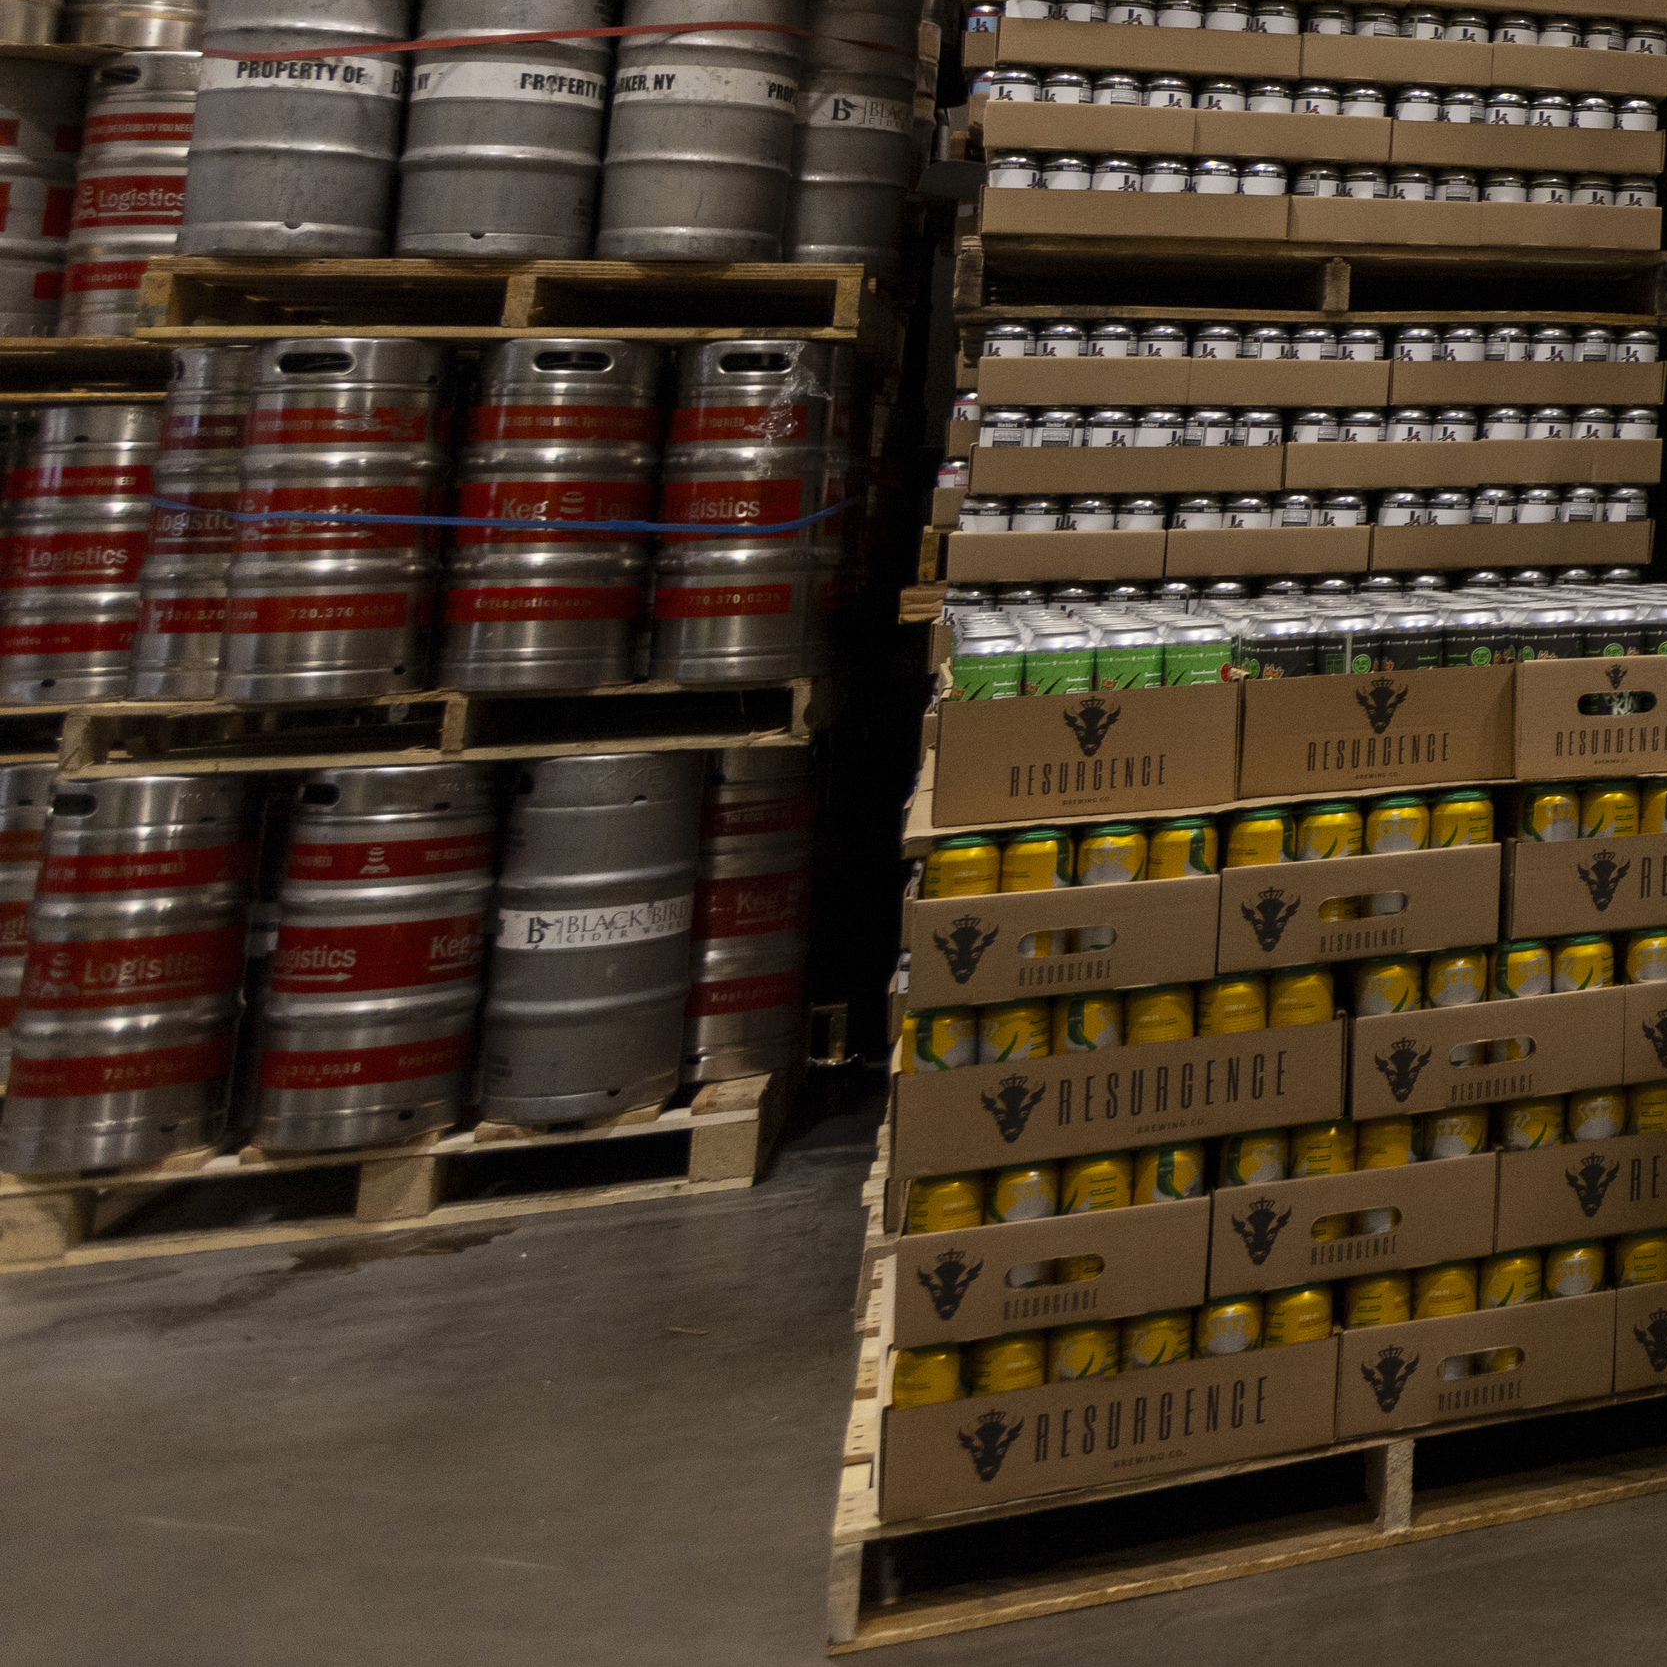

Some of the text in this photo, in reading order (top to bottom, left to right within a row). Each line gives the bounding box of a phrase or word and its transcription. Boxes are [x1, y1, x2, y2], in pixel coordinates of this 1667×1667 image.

[236, 61, 365, 84] PROPERTY OF
[654, 73, 676, 90] NY
[502, 500, 548, 521] Keg
[29, 545, 129, 572] Logistics
[1307, 732, 1449, 772] RESURGENCE
[1009, 754, 1166, 798] RESURGENCE
[566, 909, 644, 934] BLACK
[565, 930, 629, 944] CIDER
[1320, 926, 1406, 954] RESURGENCE
[1018, 959, 1112, 988] RESURGENCE
[1057, 1050, 1288, 1128] RESURGENCE
[1450, 1073, 1534, 1104] RESURGENCE
[1310, 1235, 1397, 1267] RESURGENCE
[1002, 1287, 1100, 1322] RESURGENCE
[1438, 1379, 1522, 1413] RESURGENCE
[1034, 1375, 1269, 1464] RESURGENCE
